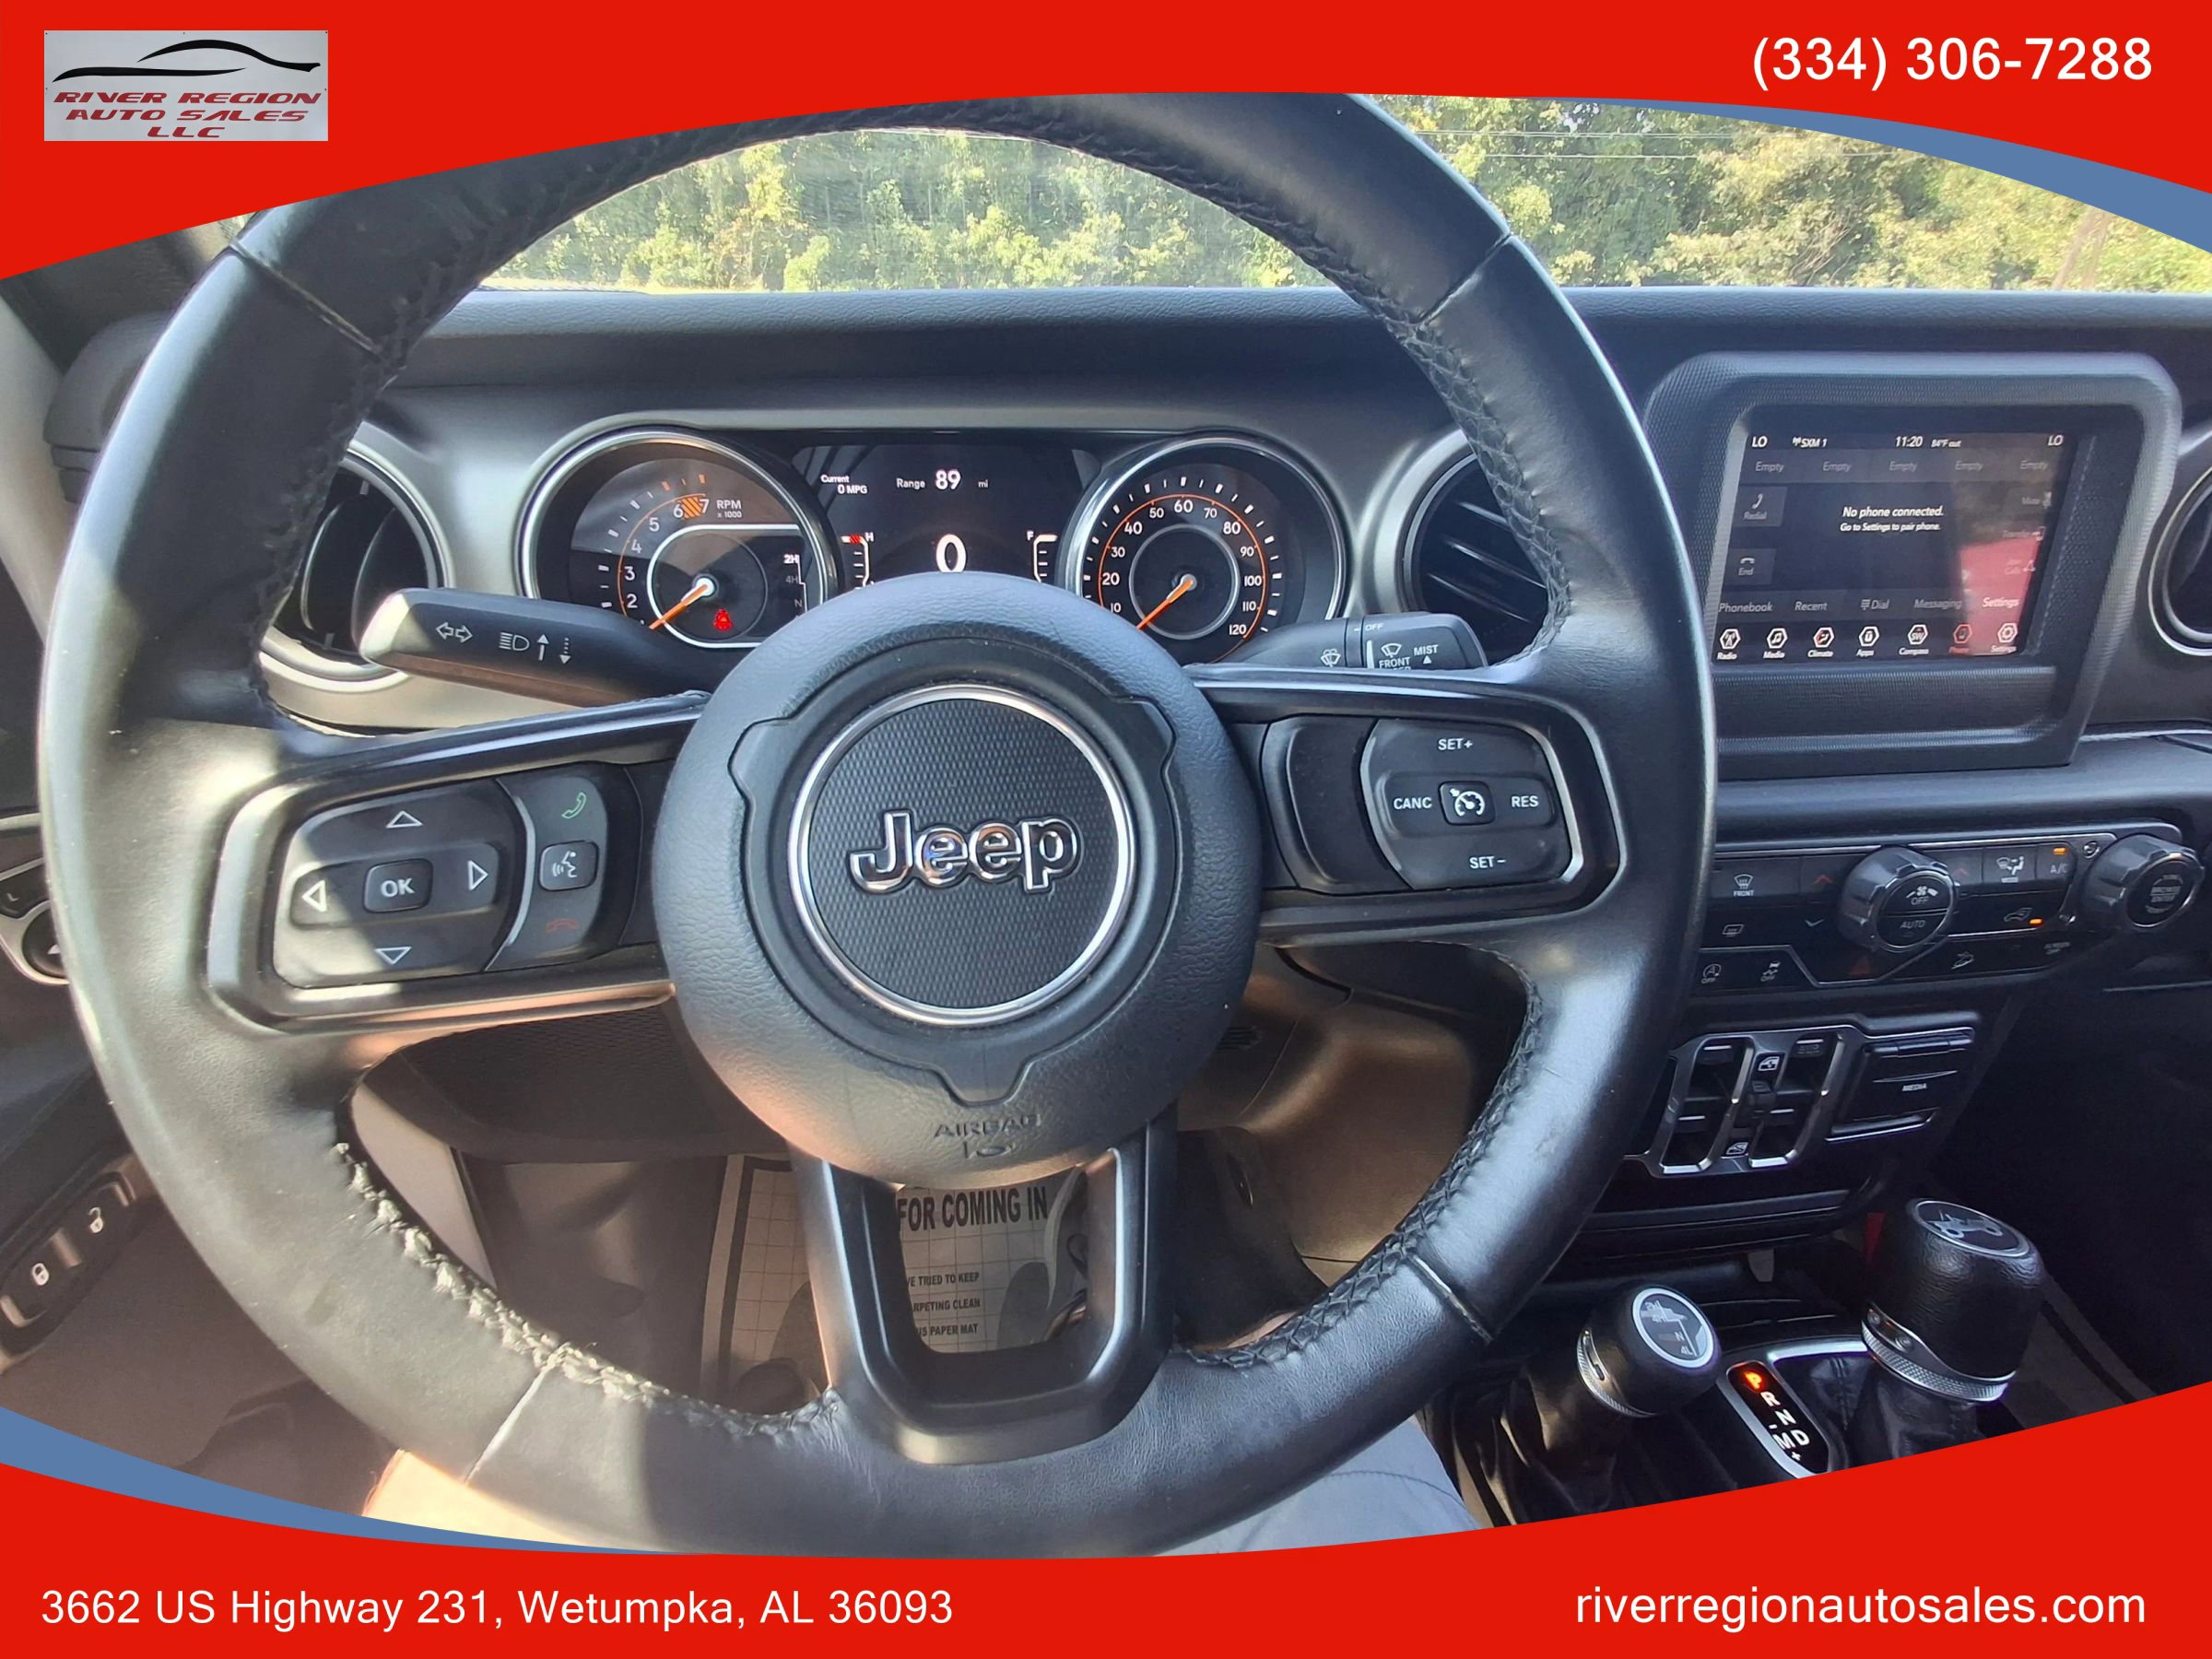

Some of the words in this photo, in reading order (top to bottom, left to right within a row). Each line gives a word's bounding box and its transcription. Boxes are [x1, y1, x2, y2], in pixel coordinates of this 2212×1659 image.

[1752, 436, 1768, 448] LO
[1895, 436, 1924, 447] 11:20
[2048, 435, 2064, 446] LO
[1756, 462, 1784, 473] Empty
[1822, 462, 1852, 473] Empty
[1889, 461, 1917, 472] Empty
[1955, 461, 1983, 471] Empty
[2019, 461, 2048, 471] Empty
[820, 474, 850, 483] Current
[896, 477, 925, 489] Range
[935, 469, 961, 490] 89
[978, 479, 988, 488] mi
[837, 484, 845, 494] 0
[846, 485, 867, 494] MPG
[673, 504, 684, 518] 6
[700, 499, 710, 513] 7
[716, 500, 741, 510] RPM
[1173, 500, 1193, 513] 60
[1149, 507, 1164, 519] 50
[1204, 508, 1218, 519] 70
[1842, 507, 1857, 517] No
[1859, 507, 1889, 519] phone
[1892, 506, 1944, 517] connected.
[649, 517, 660, 532] 5
[1124, 522, 1143, 535] 40
[1223, 522, 1241, 535] 80
[1840, 523, 1852, 532] Go
[1853, 524, 1861, 532] to
[1862, 523, 1890, 533] Settings
[1892, 523, 1900, 531] to
[1900, 523, 1914, 532] pair
[865, 532, 874, 542] H
[1027, 530, 1034, 541] F
[630, 539, 642, 554] 4
[1111, 547, 1125, 558] 30
[1240, 547, 1254, 558] 90
[783, 554, 799, 564] 2H
[935, 534, 967, 573] 0
[624, 566, 635, 581] 3
[1738, 567, 1754, 576] End
[1101, 572, 1120, 585] 20
[1244, 575, 1262, 587] 100
[627, 594, 638, 609] 2
[794, 599, 803, 607] N
[1242, 601, 1257, 612] 110
[1718, 602, 1773, 613] Phonebook
[1794, 601, 1828, 611] Recent
[1871, 599, 1889, 609] Dial
[1914, 599, 1962, 610] Messaging
[1983, 597, 2020, 608] Settings
[1110, 603, 1122, 613] 10
[1229, 624, 1246, 635] 120
[1365, 622, 1383, 631] OFF
[1414, 644, 1439, 656] MIST
[1379, 656, 1410, 669] FRONT
[1438, 737, 1473, 751] SET+
[1394, 797, 1432, 809] CANC
[1512, 795, 1539, 807] RES
[848, 808, 1083, 893] Jeep
[2050, 863, 2069, 874] A/C
[380, 878, 415, 898] OK
[1911, 897, 1929, 906] OFF
[1900, 920, 1925, 929] AUTO
[898, 1197, 935, 1231] FOR
[942, 1188, 1021, 1228] COMING
[1027, 1186, 1048, 1220] IN
[918, 1275, 943, 1286] TRIED
[944, 1274, 956, 1284] TO
[959, 1272, 980, 1283] KEEP
[952, 1298, 981, 1310] CLEAN
[930, 1324, 959, 1335] PAPER
[960, 1324, 978, 1334] MAT
[1744, 1371, 1762, 1390] P
[1760, 1391, 1781, 1406] R
[1774, 1408, 1796, 1425] N
[1772, 1432, 1796, 1450] M
[1790, 1430, 1810, 1446] D
